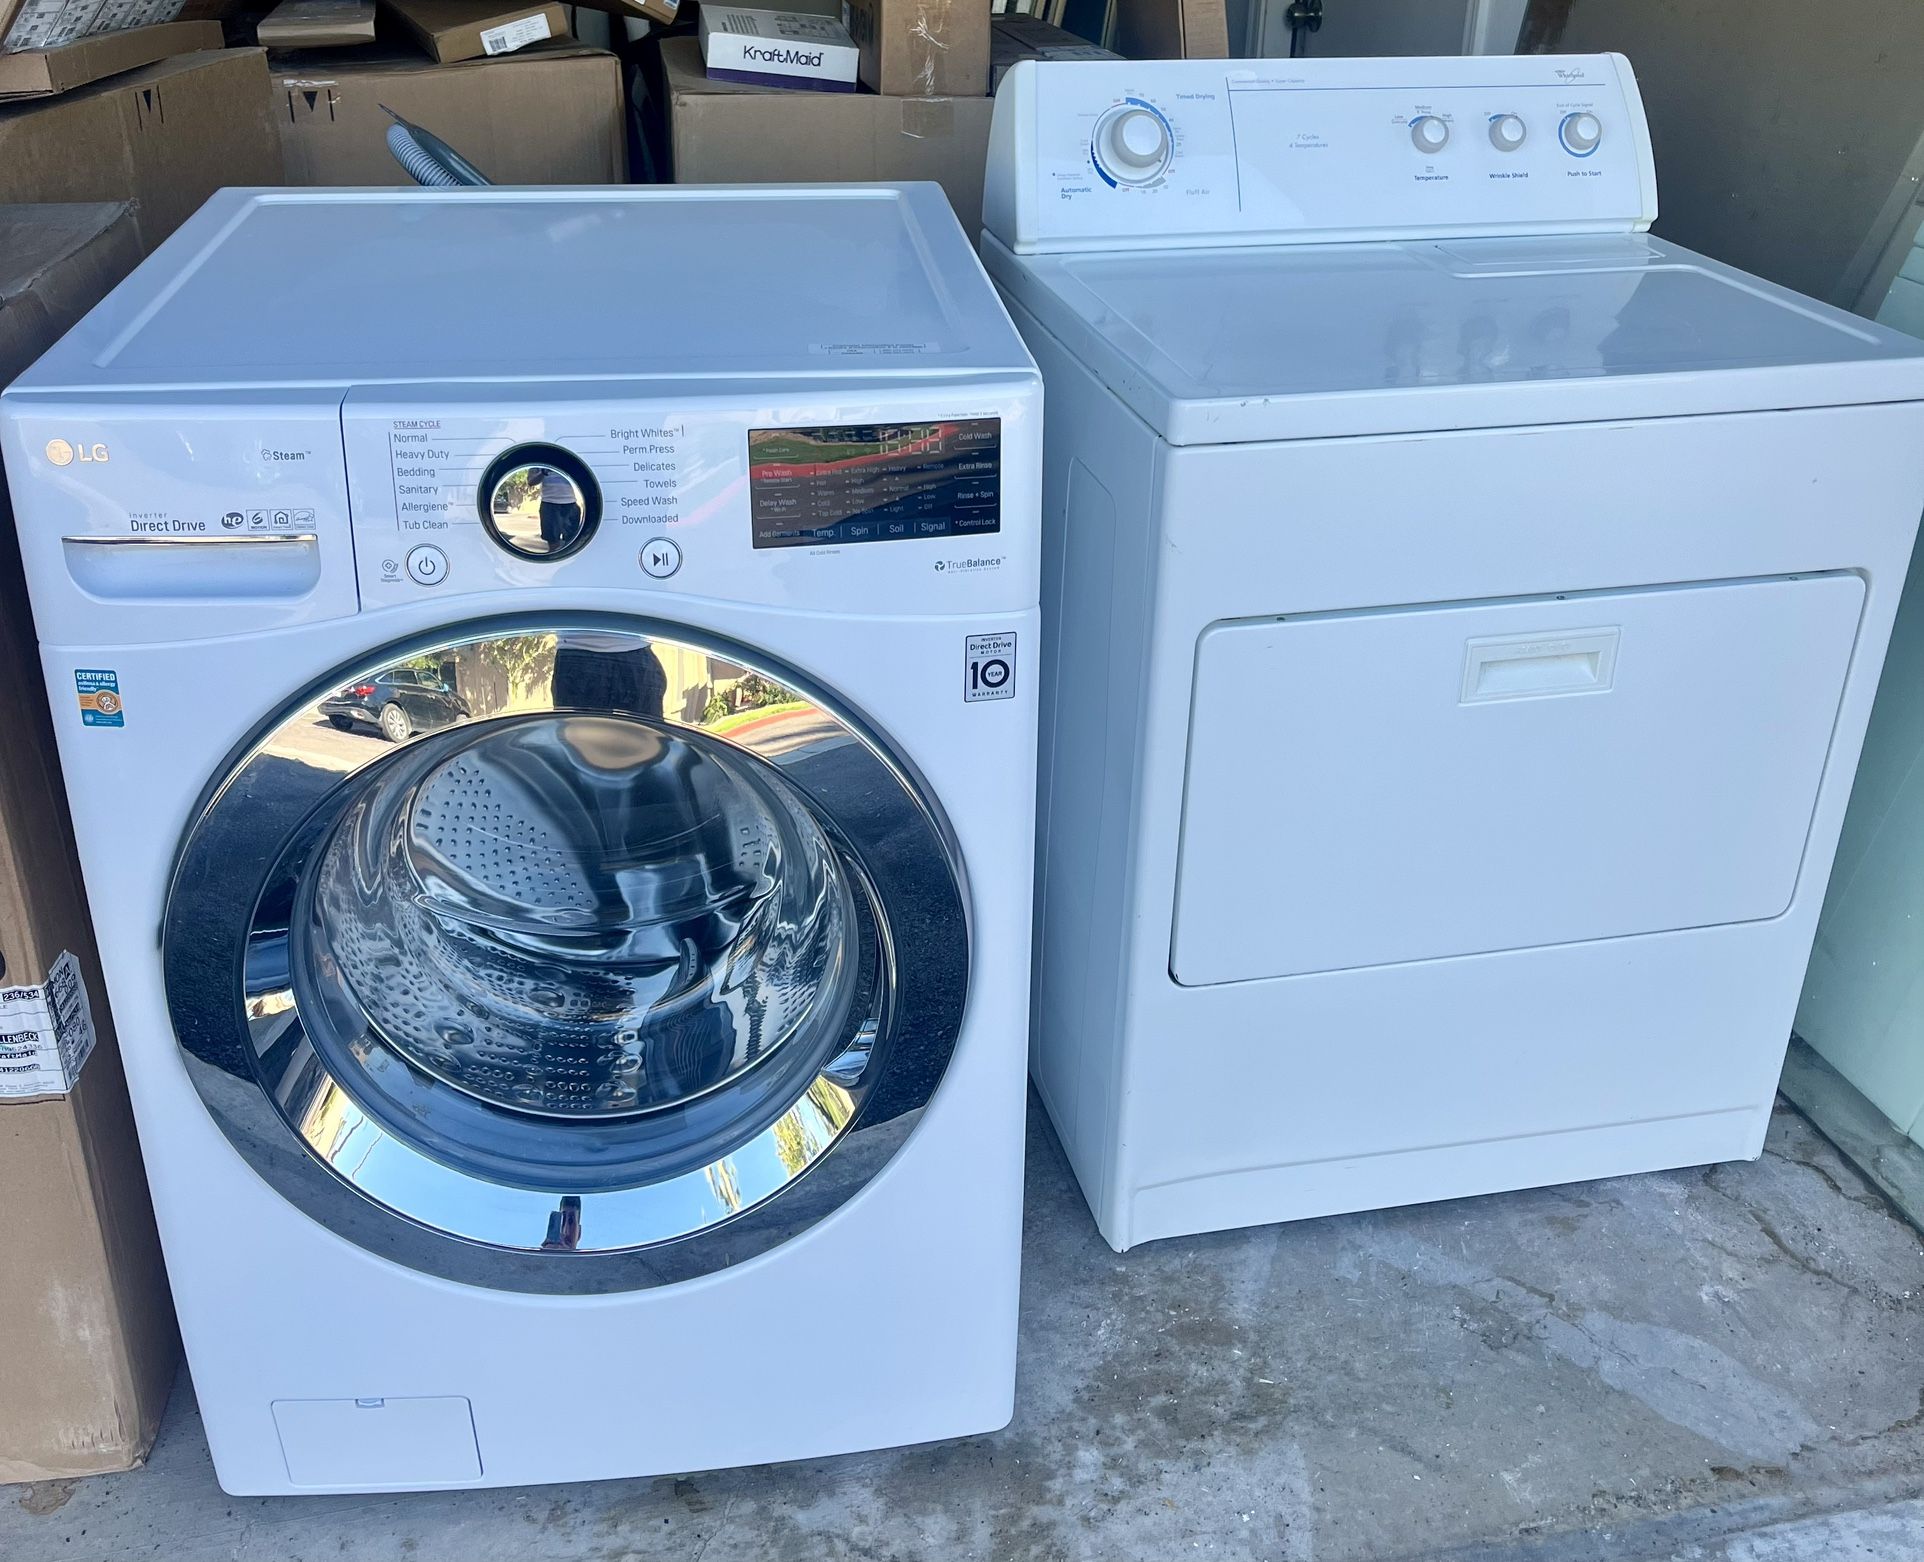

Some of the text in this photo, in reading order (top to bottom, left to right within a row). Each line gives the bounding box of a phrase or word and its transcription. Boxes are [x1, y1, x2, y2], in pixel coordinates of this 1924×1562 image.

[743, 45, 824, 67] KraftMaid
[393, 420, 441, 429] STEAM CYCLE
[394, 433, 428, 443] Normal
[610, 429, 639, 440] Bright
[77, 443, 109, 462] LG
[395, 449, 450, 460] Heavy Duty
[650, 445, 675, 454] Press
[633, 461, 676, 471] Delicates
[397, 467, 436, 477] Bedding
[644, 479, 677, 488] Towels
[399, 484, 439, 495] Sanitary
[981, 491, 994, 499] Spin
[621, 496, 678, 507] Speed Wash
[403, 520, 448, 529] Tub Clean
[621, 514, 679, 525] Downloaded
[959, 518, 996, 527] Control Lock
[131, 519, 206, 533] Direct Drive
[889, 523, 904, 533] Soil
[921, 521, 945, 532] Signal
[851, 527, 869, 536] Spin
[77, 672, 115, 681] CERTIFIED
[971, 659, 1010, 690] 10
[3, 990, 39, 1002] 236/534
